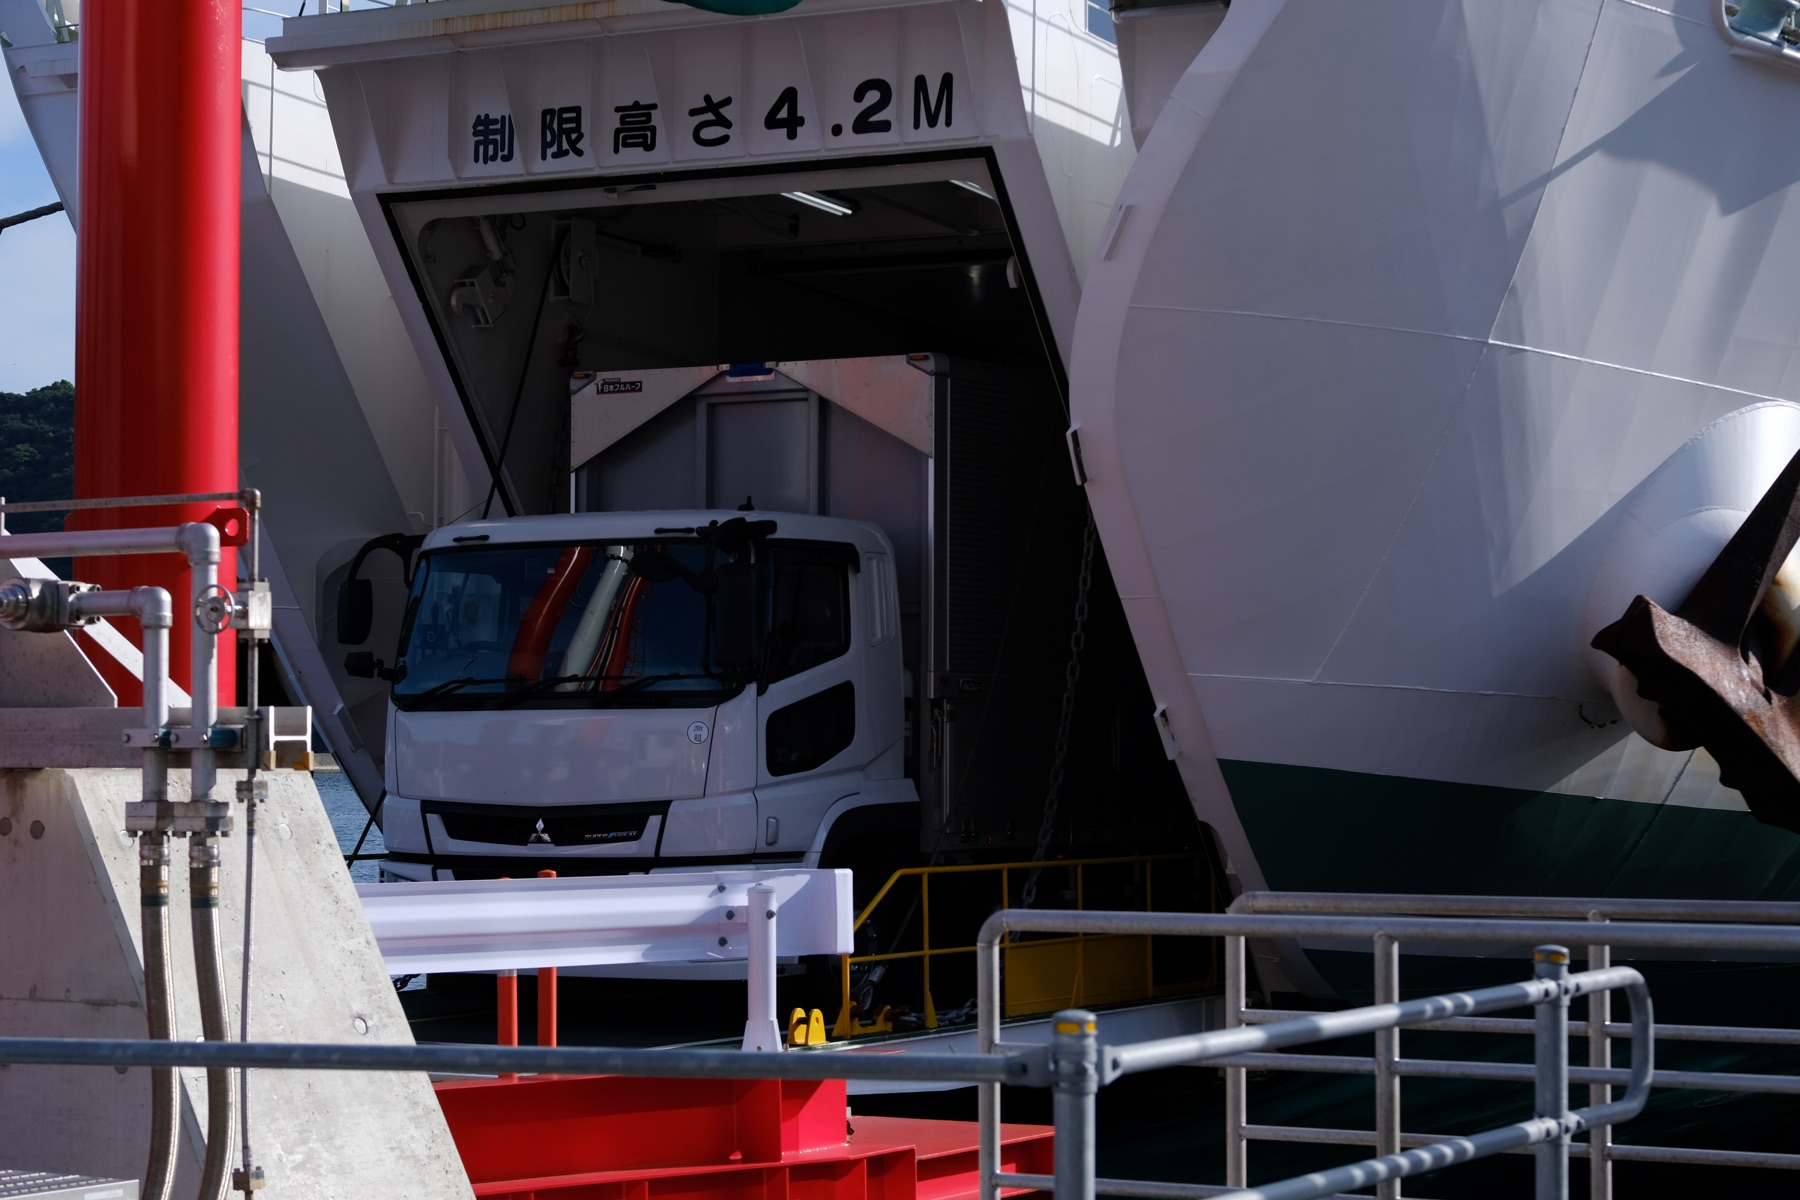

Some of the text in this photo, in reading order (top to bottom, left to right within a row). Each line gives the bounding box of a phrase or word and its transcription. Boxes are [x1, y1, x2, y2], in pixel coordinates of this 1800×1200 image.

[472, 72, 954, 165] 制限高さ4.2M
[603, 382, 641, 392] 日本フルハーフ
